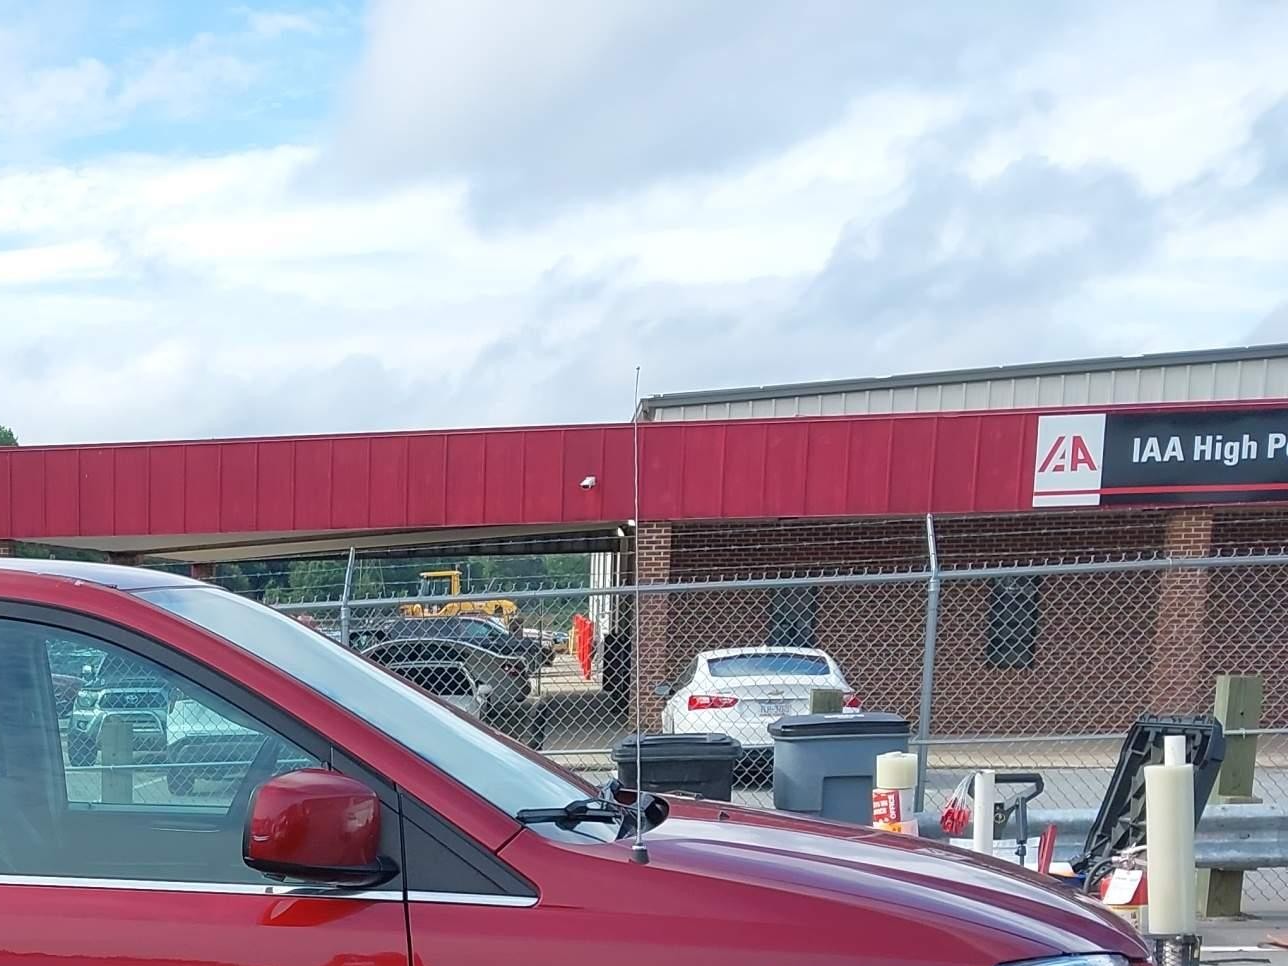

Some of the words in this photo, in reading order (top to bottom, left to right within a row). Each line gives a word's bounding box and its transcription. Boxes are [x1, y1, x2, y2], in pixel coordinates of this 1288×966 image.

[1132, 436, 1185, 462] IAA
[1193, 434, 1258, 466] High
[1267, 433, 1288, 459] P
